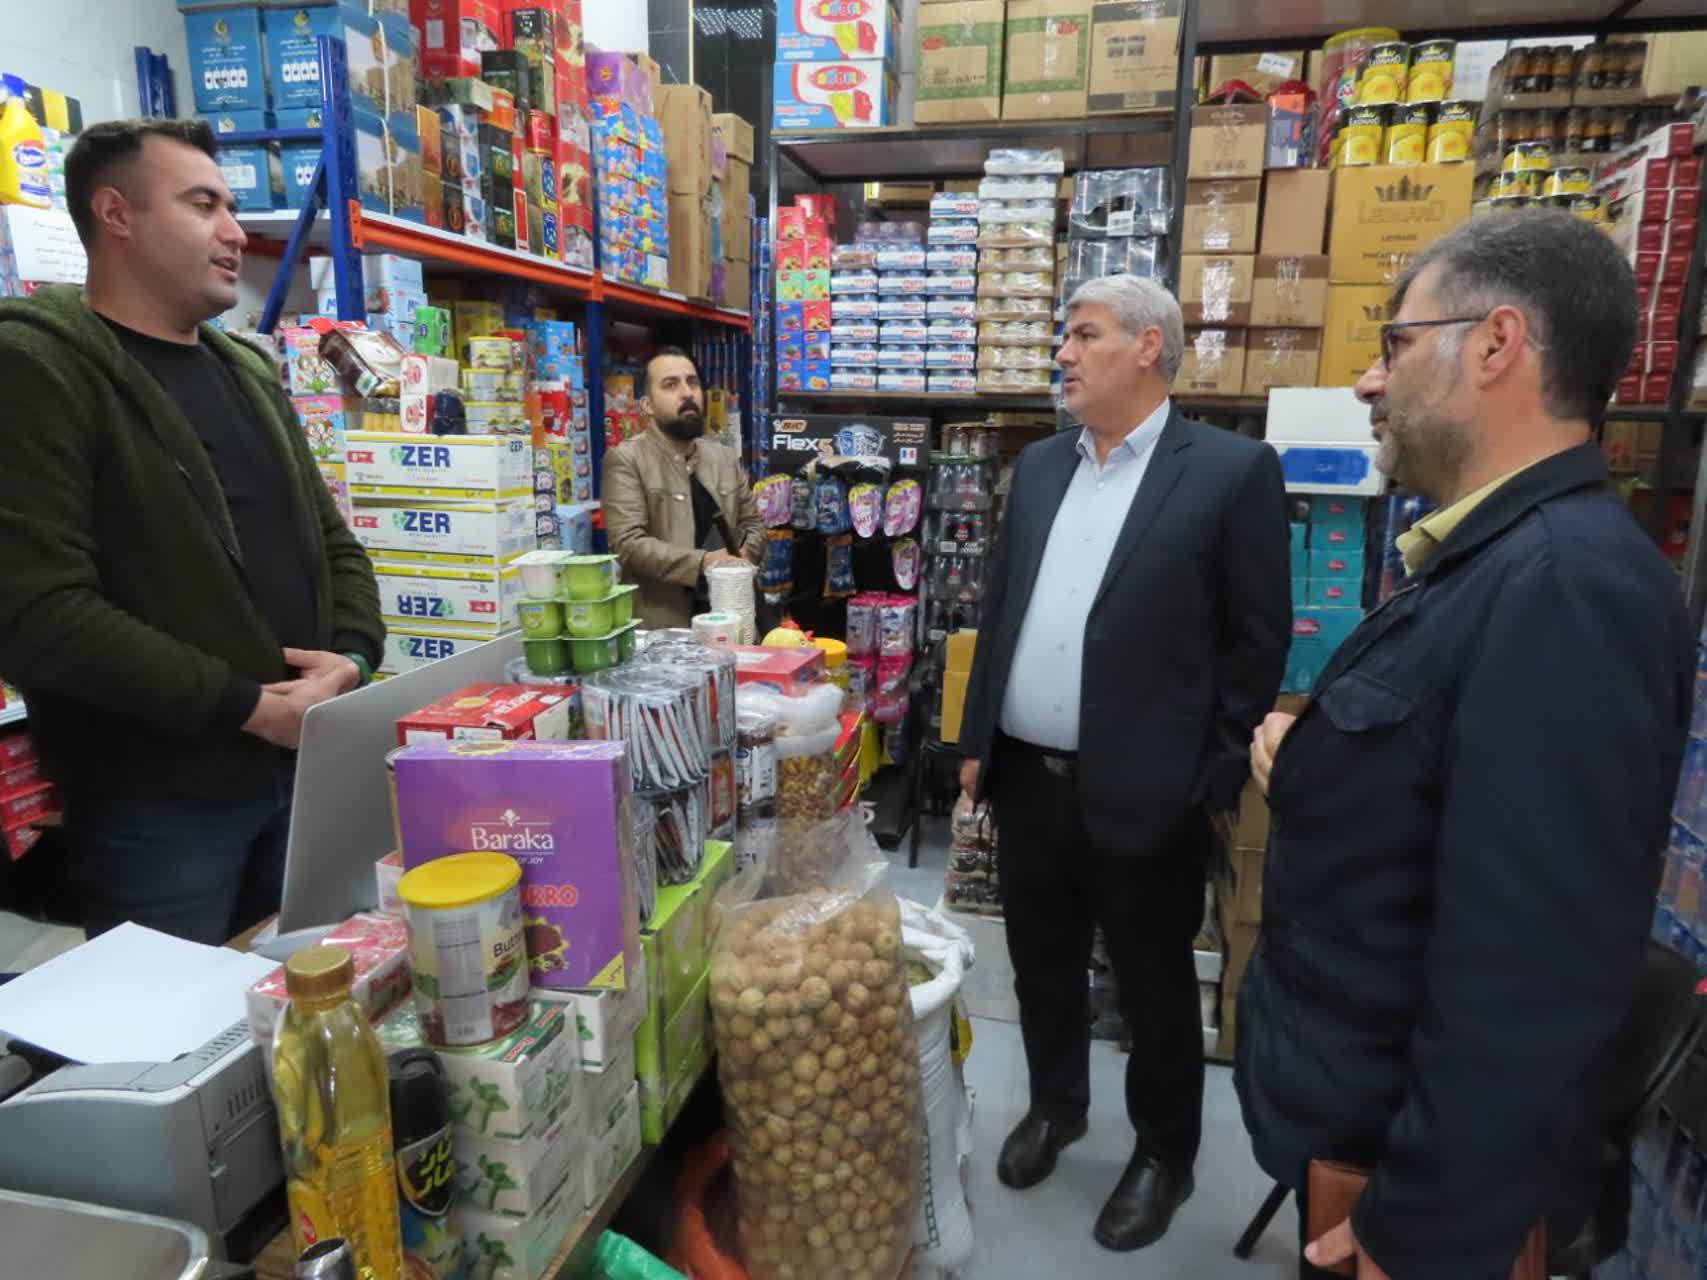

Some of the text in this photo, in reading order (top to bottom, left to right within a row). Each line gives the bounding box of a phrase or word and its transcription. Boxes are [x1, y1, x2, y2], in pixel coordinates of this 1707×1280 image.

[783, 421, 804, 431] BIC
[401, 445, 450, 468] ZER
[510, 440, 523, 453] ZER
[403, 511, 450, 534] ZER
[397, 594, 444, 617] ZER
[408, 637, 455, 660] ZER
[471, 827, 553, 850] Baraka
